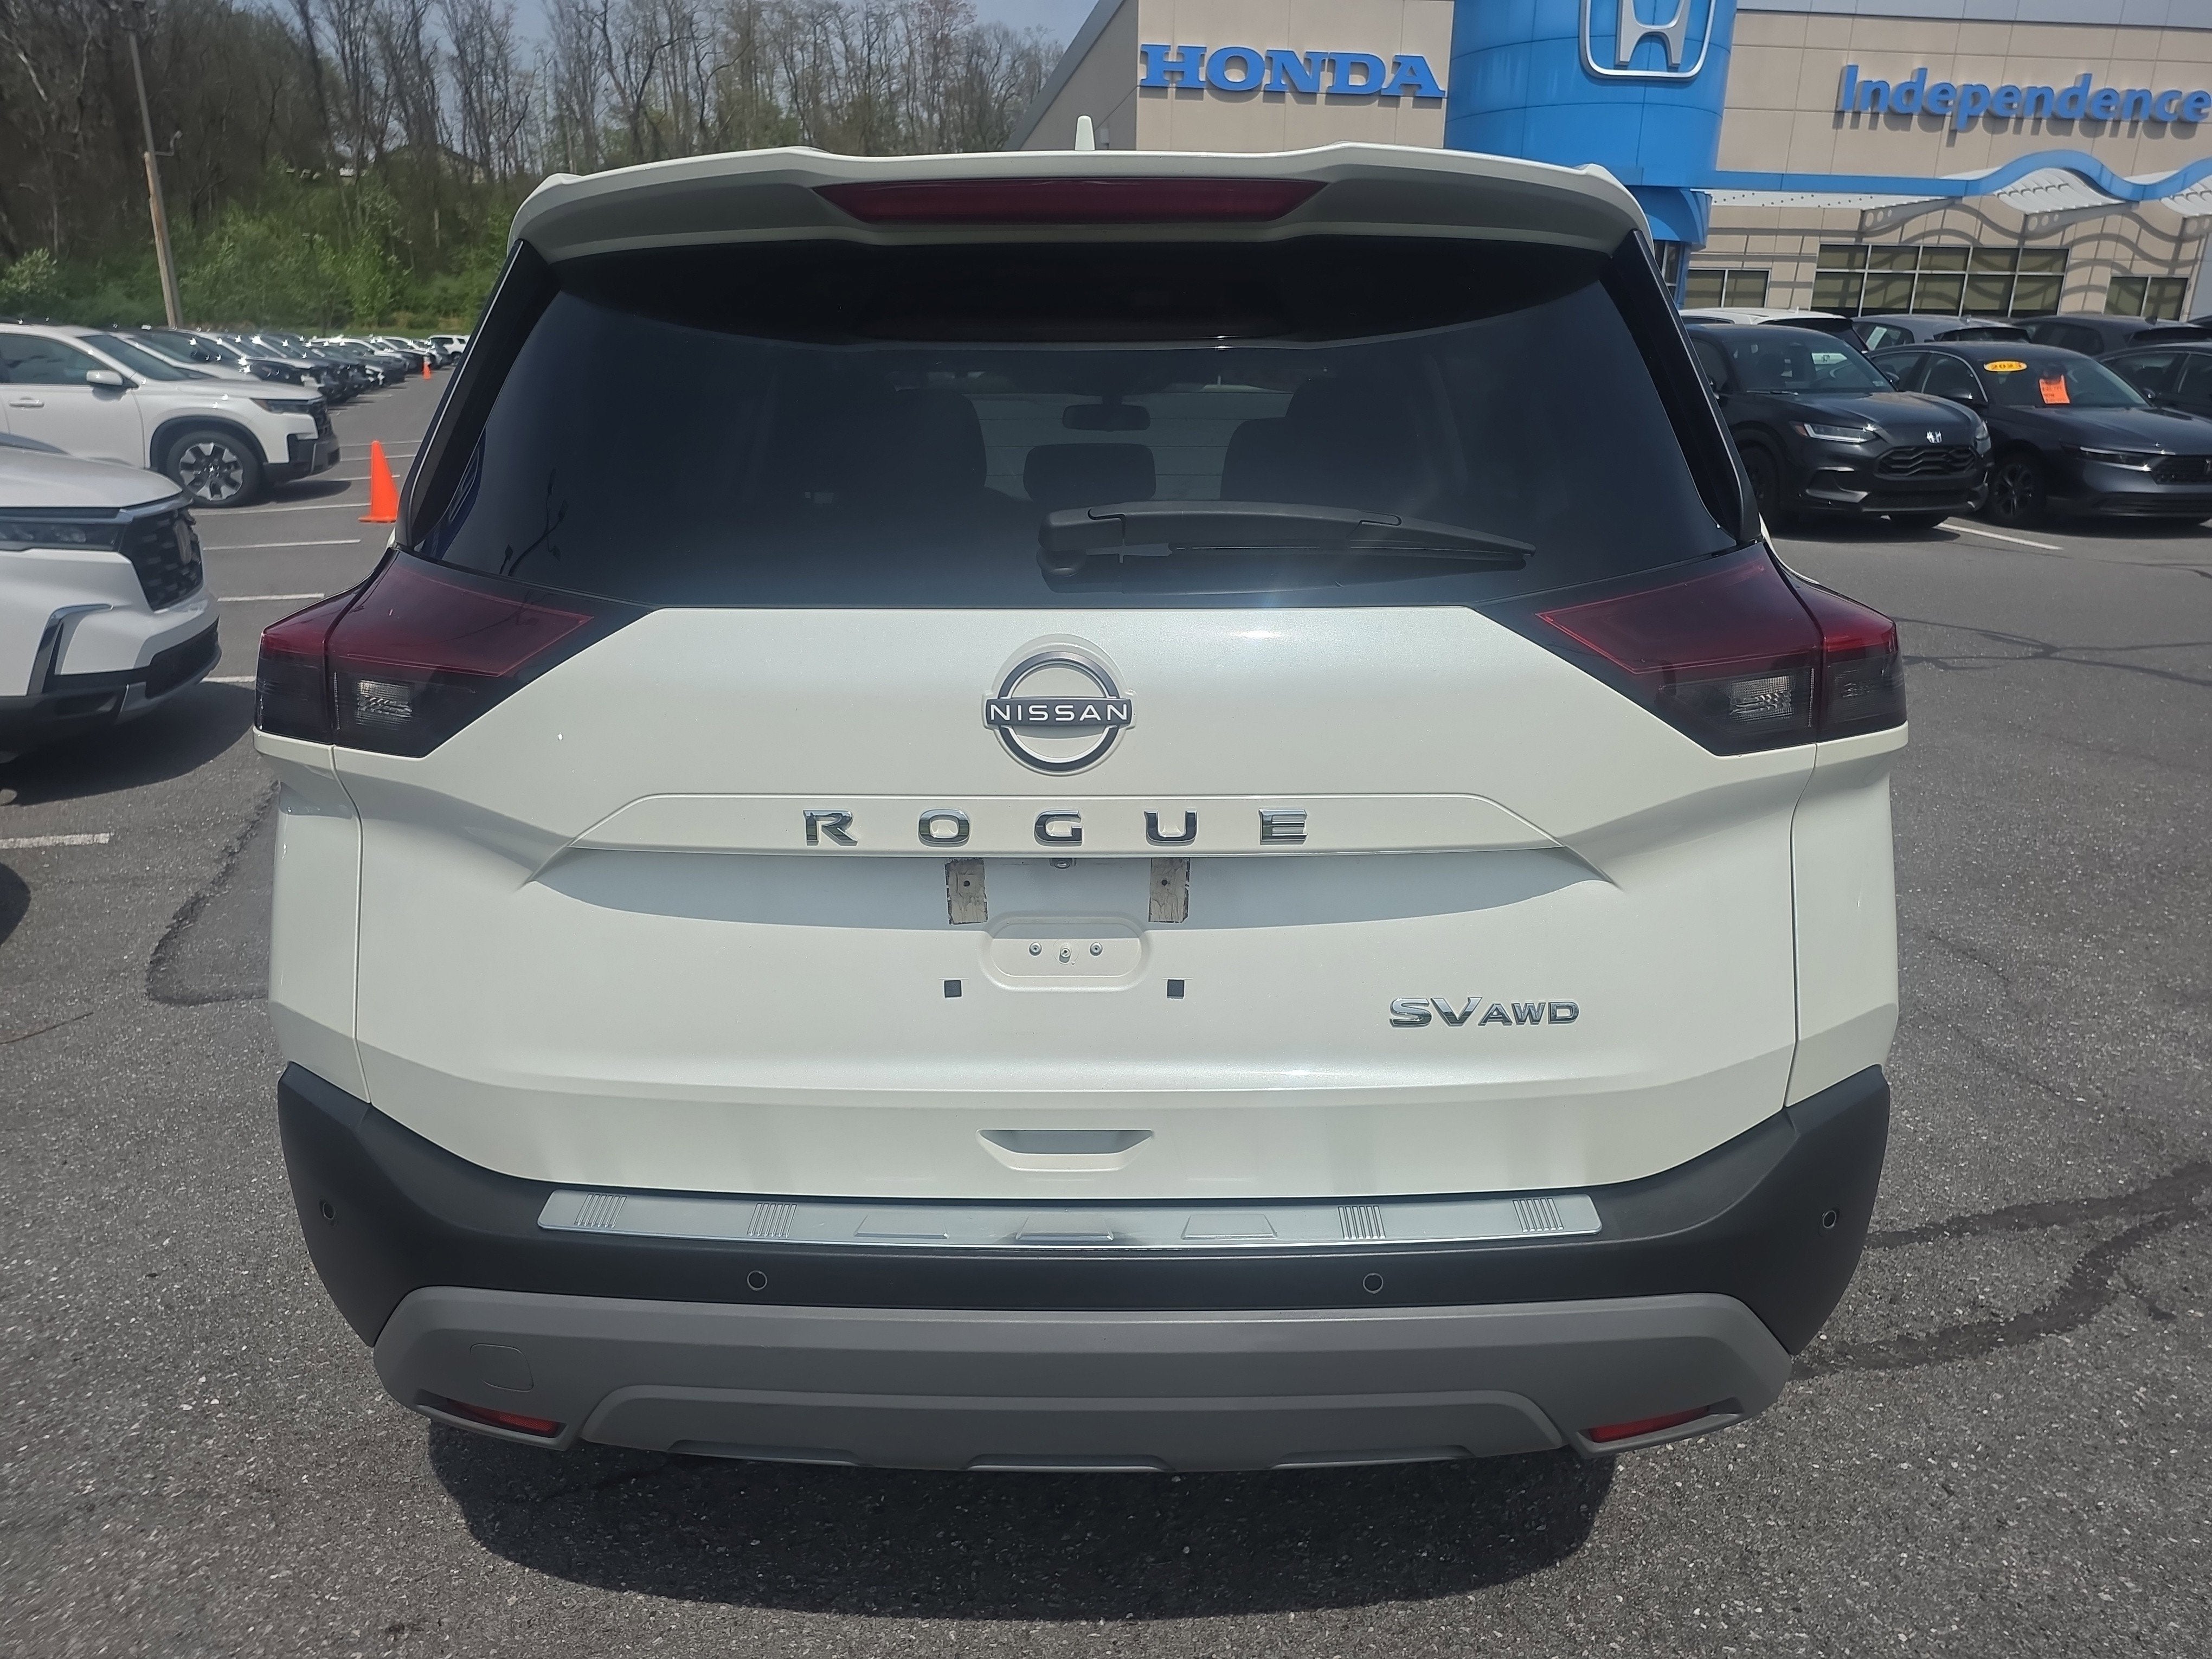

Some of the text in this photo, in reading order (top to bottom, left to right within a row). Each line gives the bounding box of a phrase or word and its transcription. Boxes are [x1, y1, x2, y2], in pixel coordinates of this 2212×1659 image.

[1140, 43, 1446, 98] HONDA
[1838, 64, 2211, 131] Independence
[990, 704, 1127, 721] NISSAN
[802, 808, 1309, 846] ROGUE
